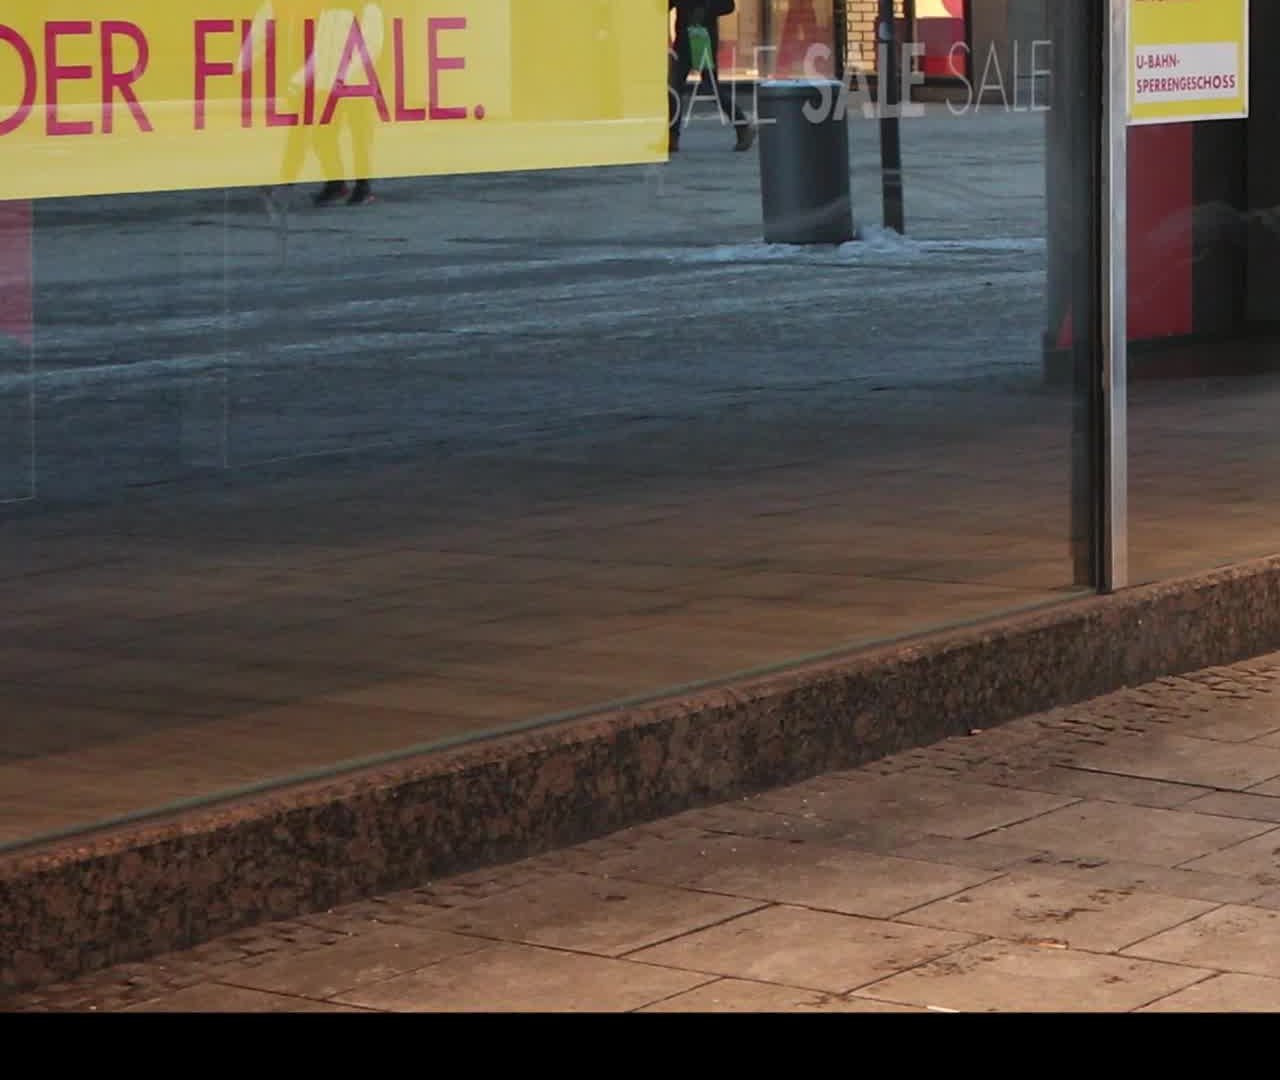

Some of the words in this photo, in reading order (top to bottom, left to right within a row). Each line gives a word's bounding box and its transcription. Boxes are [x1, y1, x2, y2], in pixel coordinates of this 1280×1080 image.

[194, 16, 486, 129] FILIALE.
[801, 41, 925, 125] SALE
[945, 39, 1053, 116] SALE
[1136, 53, 1181, 69] U-BAHN-
[1136, 74, 1236, 94] SPERRENGESCHOSS
